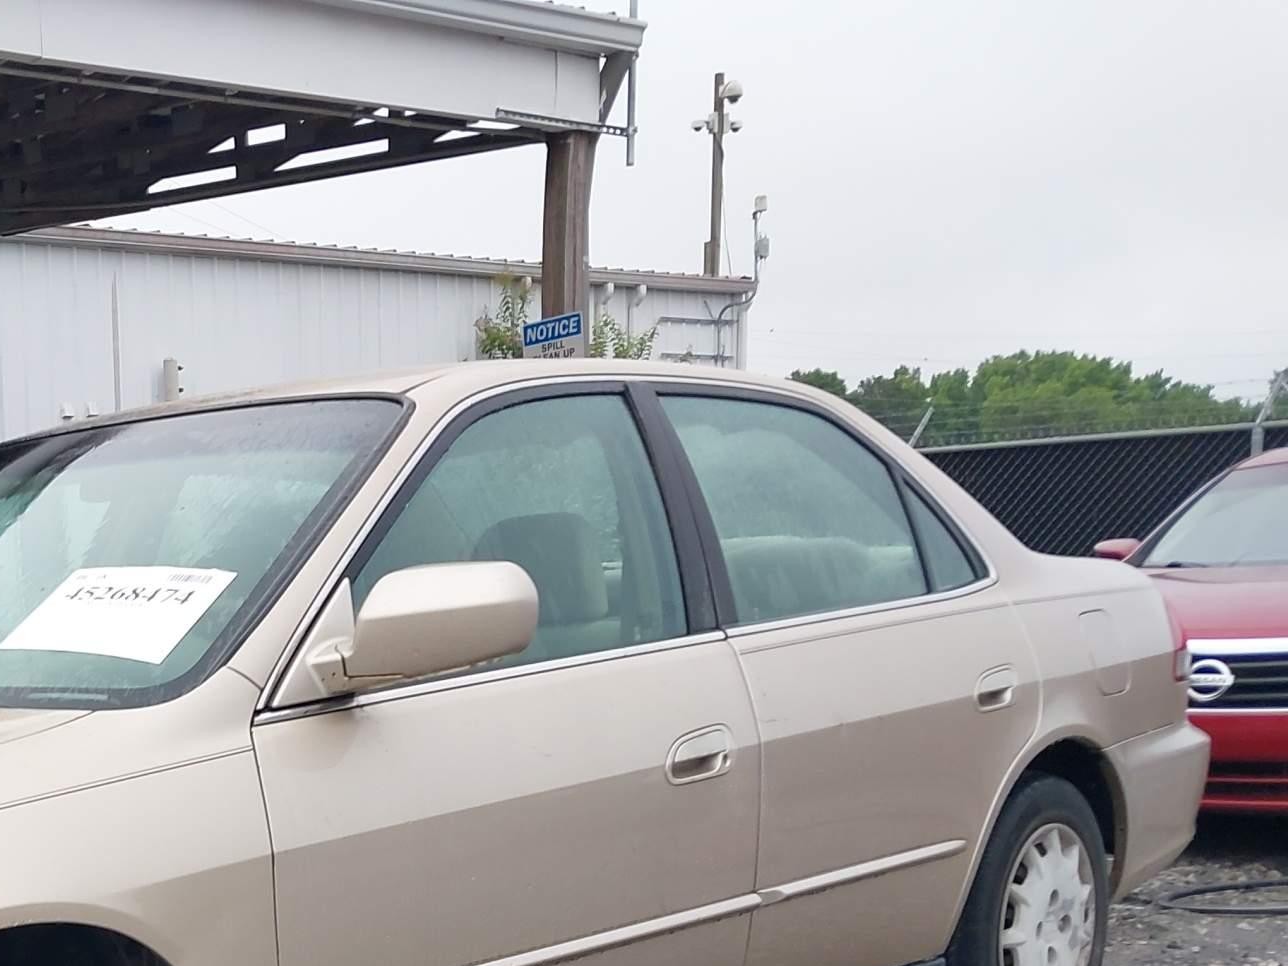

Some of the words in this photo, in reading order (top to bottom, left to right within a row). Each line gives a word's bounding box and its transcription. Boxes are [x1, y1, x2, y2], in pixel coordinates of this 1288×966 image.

[526, 316, 579, 344] NOTICE
[541, 340, 565, 353] SPILL
[564, 347, 576, 358] UP
[65, 585, 197, 605] 45268474
